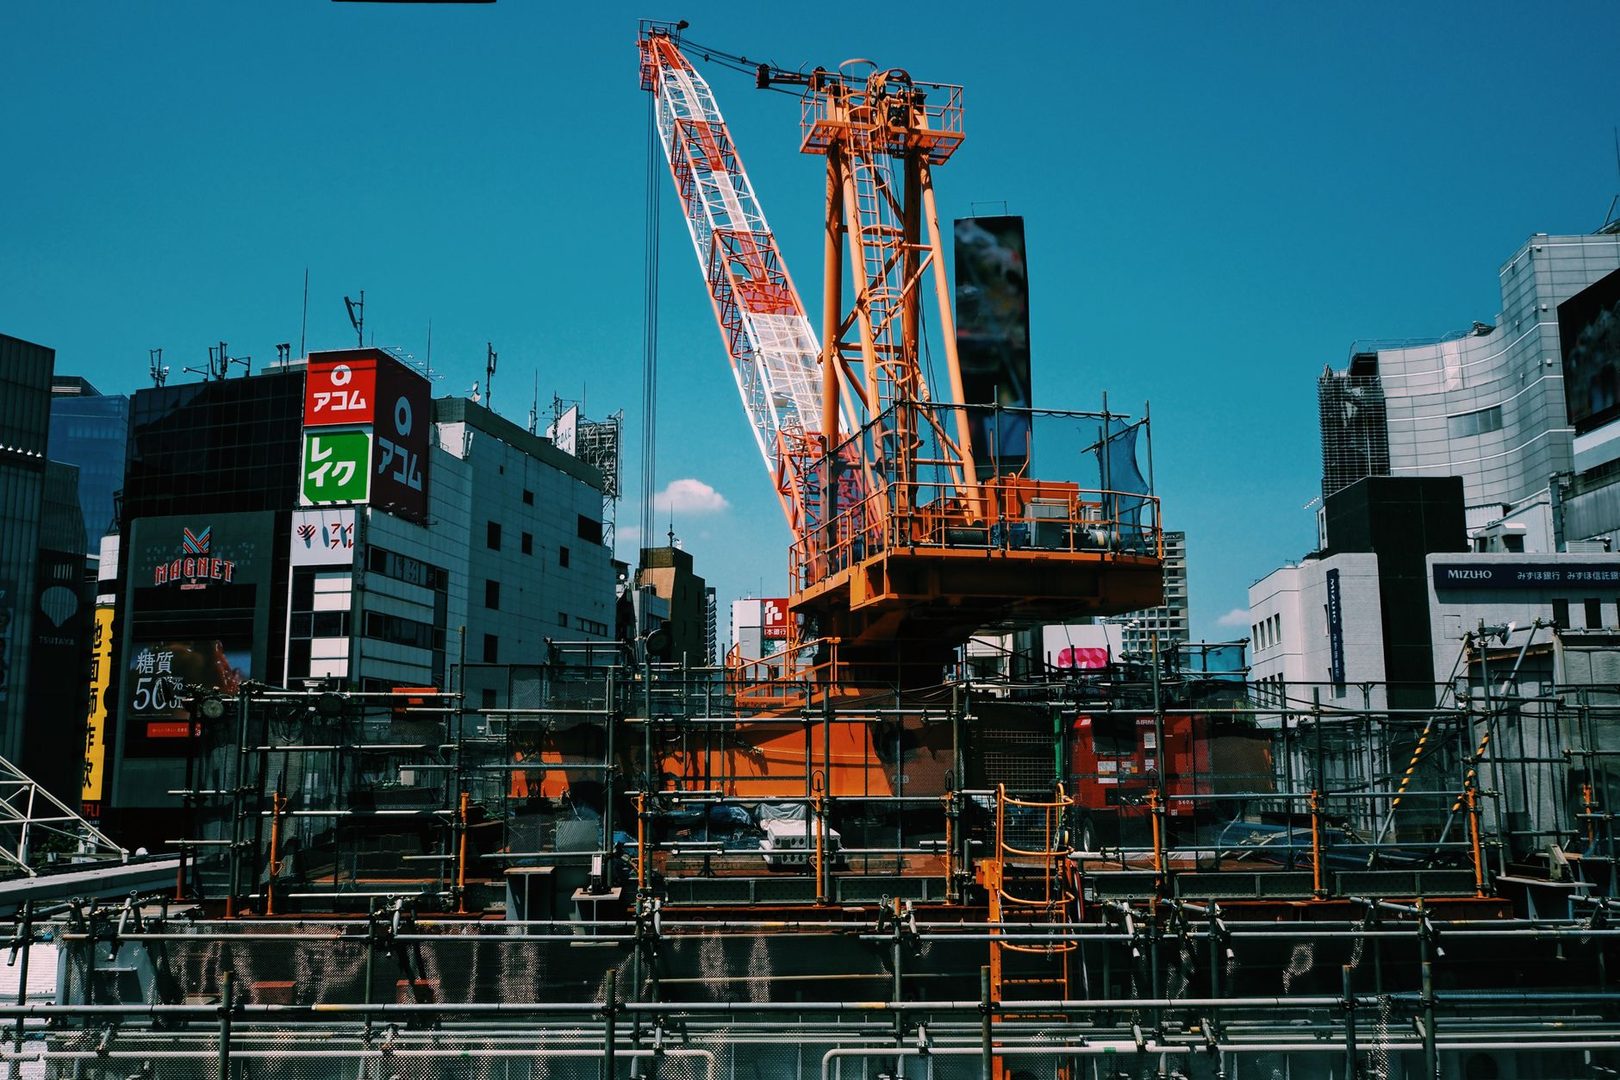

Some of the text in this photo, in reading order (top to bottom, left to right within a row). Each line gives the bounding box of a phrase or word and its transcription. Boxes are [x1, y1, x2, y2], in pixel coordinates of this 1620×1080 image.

[313, 390, 367, 413] アコム
[378, 436, 422, 492] アコム
[154, 556, 235, 586] MAGNET
[1447, 569, 1493, 579] MIZUHO
[1516, 571, 1620, 581] みずほ銀行 みずほ信託銀
[39, 636, 75, 646] TSUTAYA
[135, 651, 174, 675] 糖質
